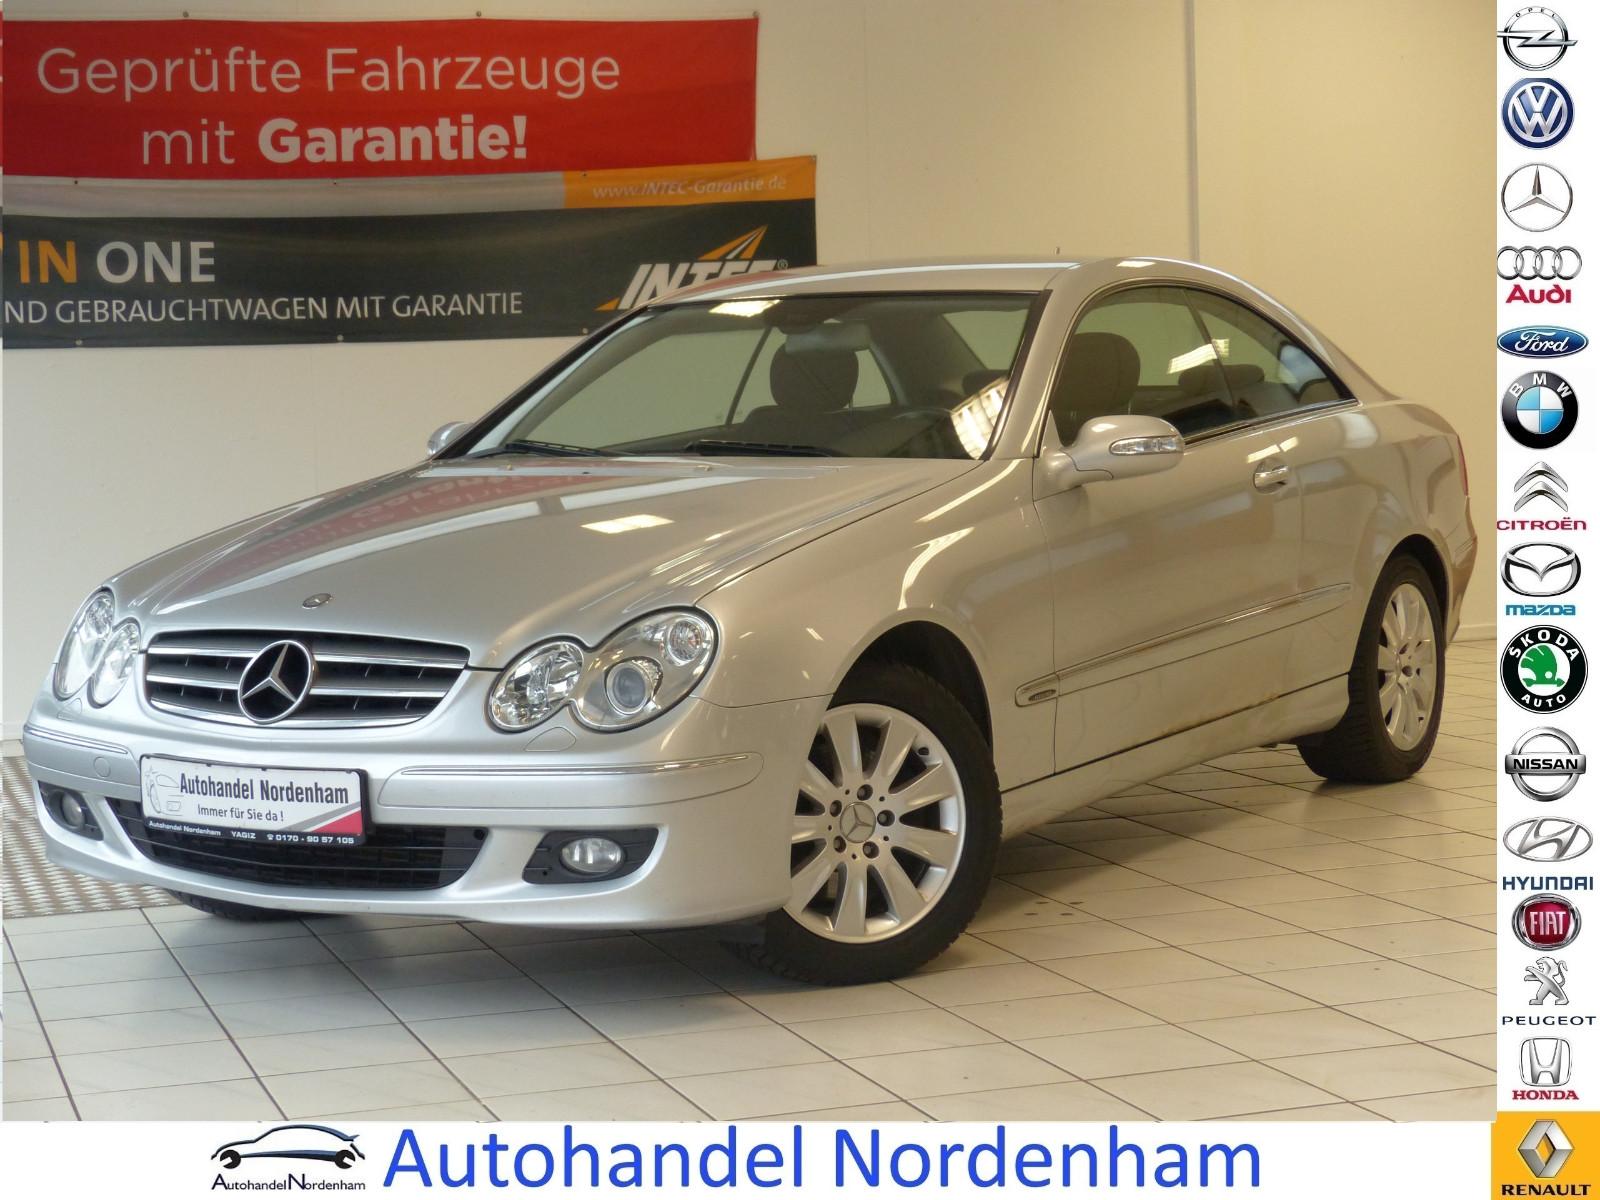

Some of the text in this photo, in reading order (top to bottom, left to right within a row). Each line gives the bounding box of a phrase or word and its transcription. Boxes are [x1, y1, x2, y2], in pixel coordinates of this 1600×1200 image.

[37, 45, 620, 102] Geprüfte Fahrzeuge
[143, 114, 527, 165] mit Garantie!
[592, 176, 786, 199] www.INTEC-Garantie.de
[19, 240, 216, 284] IN ONE
[55, 297, 328, 323] GEBRAUCHTWAGEN
[336, 296, 385, 318] MIT
[392, 292, 523, 317] GARANTIE
[180, 772, 349, 804] Autohandel Nordenham
[197, 804, 227, 817] Immer
[230, 807, 244, 819] für
[247, 809, 263, 820] Sie
[265, 811, 278, 821] da
[148, 820, 182, 832] Autohandel
[183, 825, 221, 836] Nordenham
[275, 834, 299, 842] 0170
